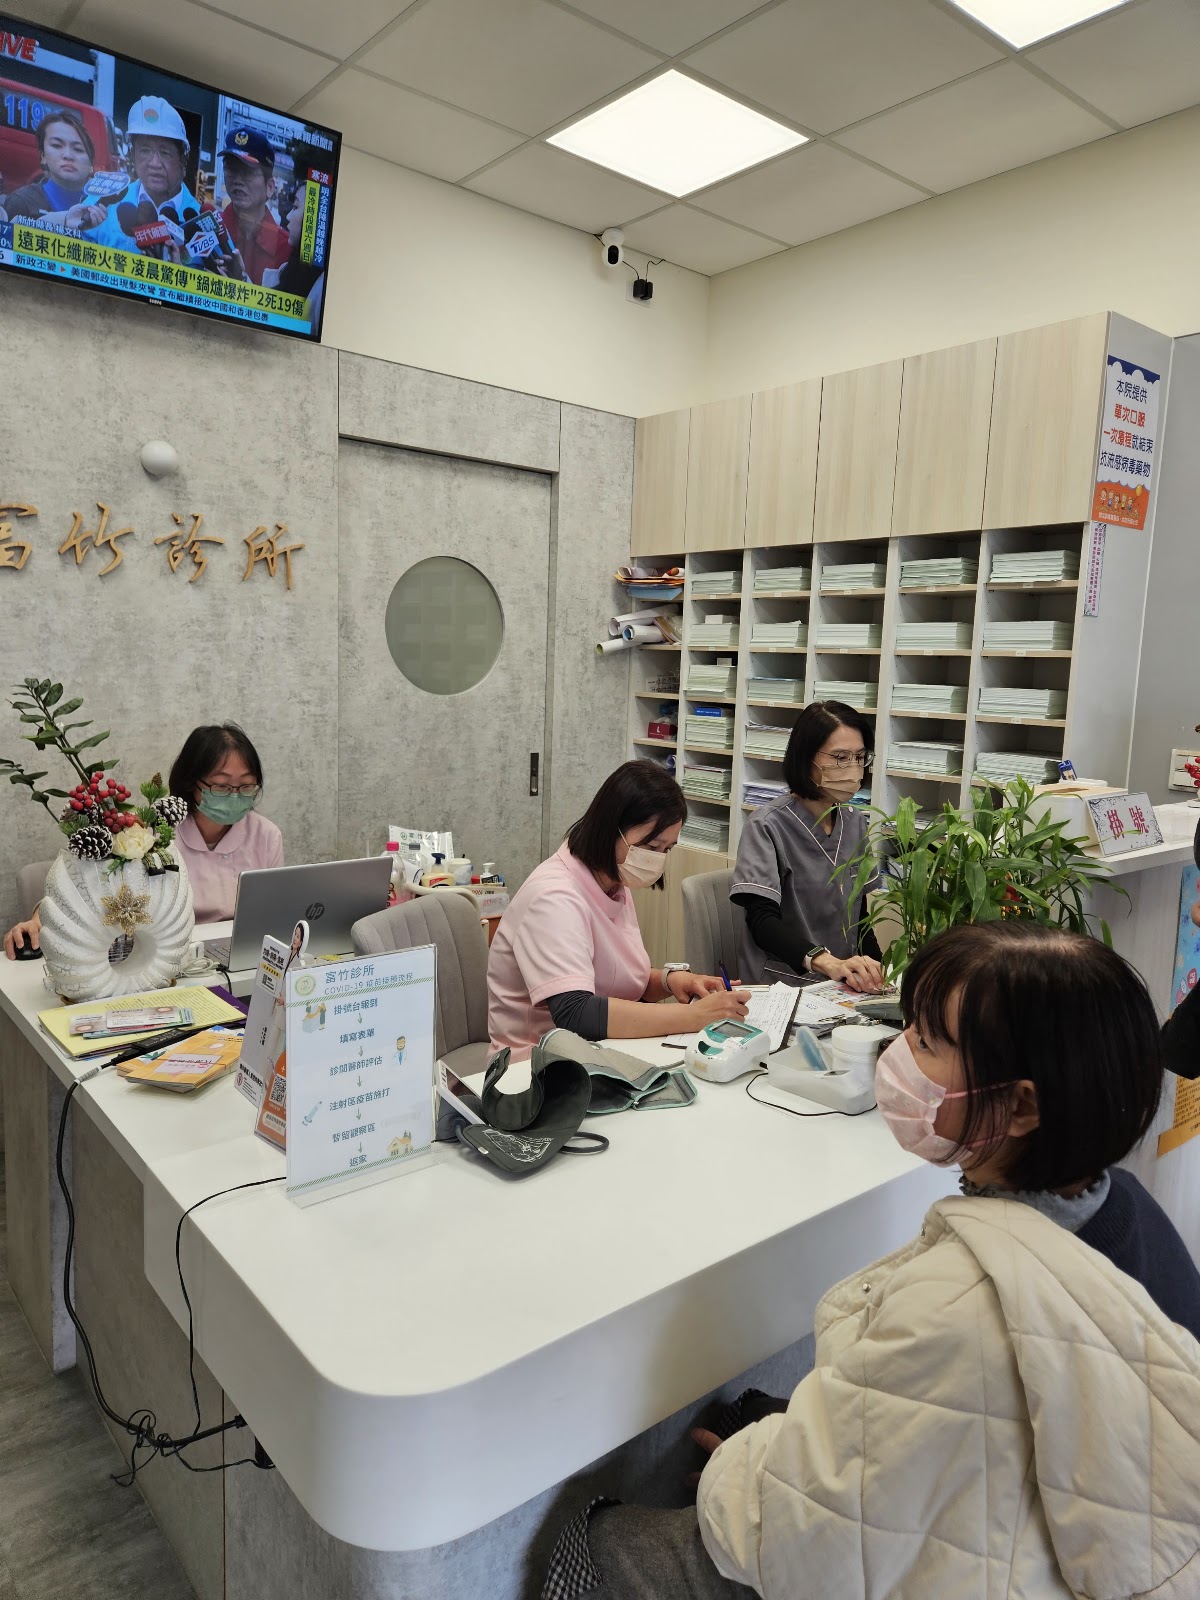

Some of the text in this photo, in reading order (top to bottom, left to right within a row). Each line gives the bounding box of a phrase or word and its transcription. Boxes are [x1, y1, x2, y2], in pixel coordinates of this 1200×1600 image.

[5, 94, 44, 131] 119
[18, 230, 127, 273] 遠東化纖廠火警
[191, 236, 215, 254] TVBS
[1115, 379, 1148, 404] 本院提供
[1114, 403, 1146, 428] 單次口服
[1103, 427, 1154, 454] 一次療程就結束
[1100, 450, 1151, 478] 抗流感病毒藥物
[325, 964, 375, 984] 富竹診所
[324, 981, 364, 996] COVID-19
[333, 998, 378, 1015] 掛號台報到
[340, 1028, 375, 1044] 填寫表單
[329, 1056, 383, 1076] 診間醫師評估
[329, 1088, 391, 1111] 注射區疫苗施打
[332, 1122, 376, 1143] 暫留觀察區
[349, 1154, 368, 1167] 返家
